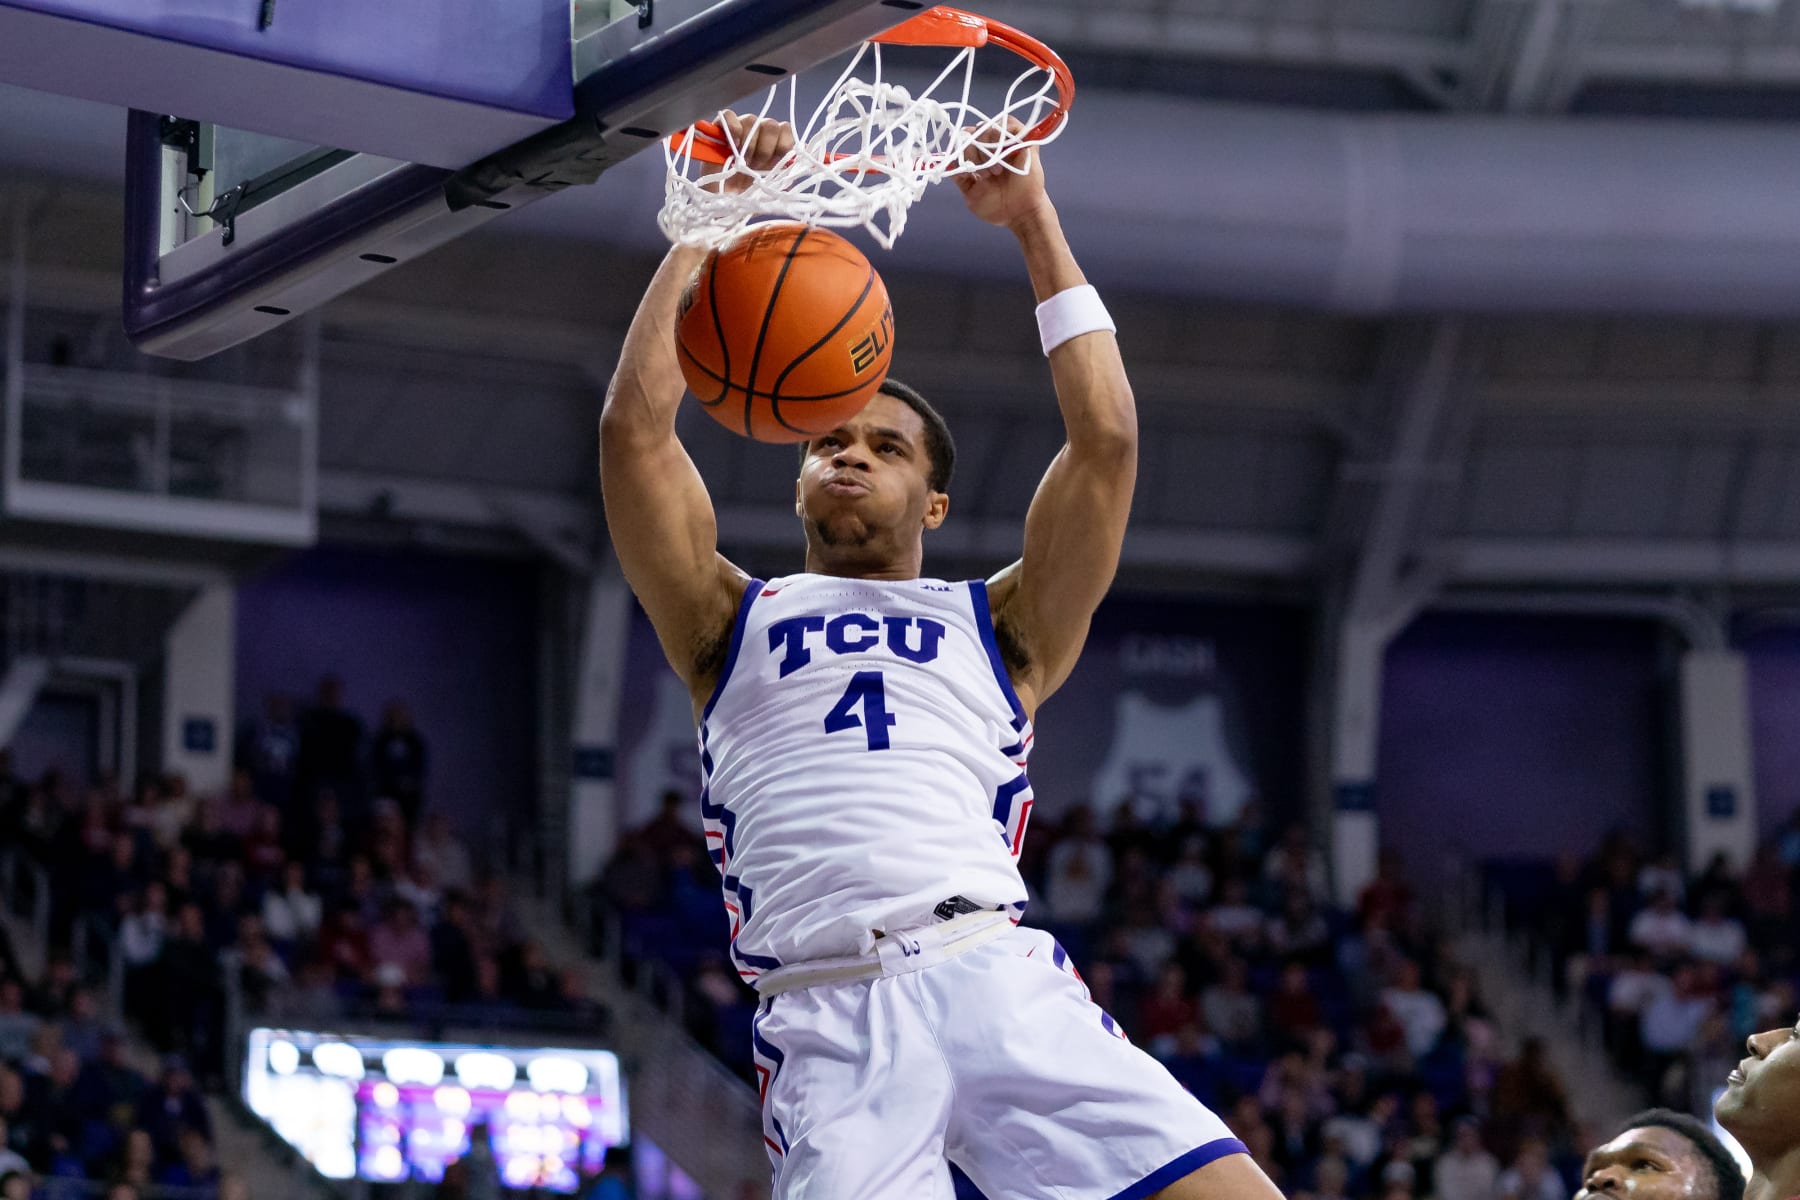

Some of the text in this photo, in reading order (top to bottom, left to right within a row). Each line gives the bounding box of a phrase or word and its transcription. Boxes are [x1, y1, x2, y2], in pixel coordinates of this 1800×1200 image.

[849, 308, 894, 376] ELIT
[768, 613, 945, 679] TCU
[824, 671, 896, 751] 4
